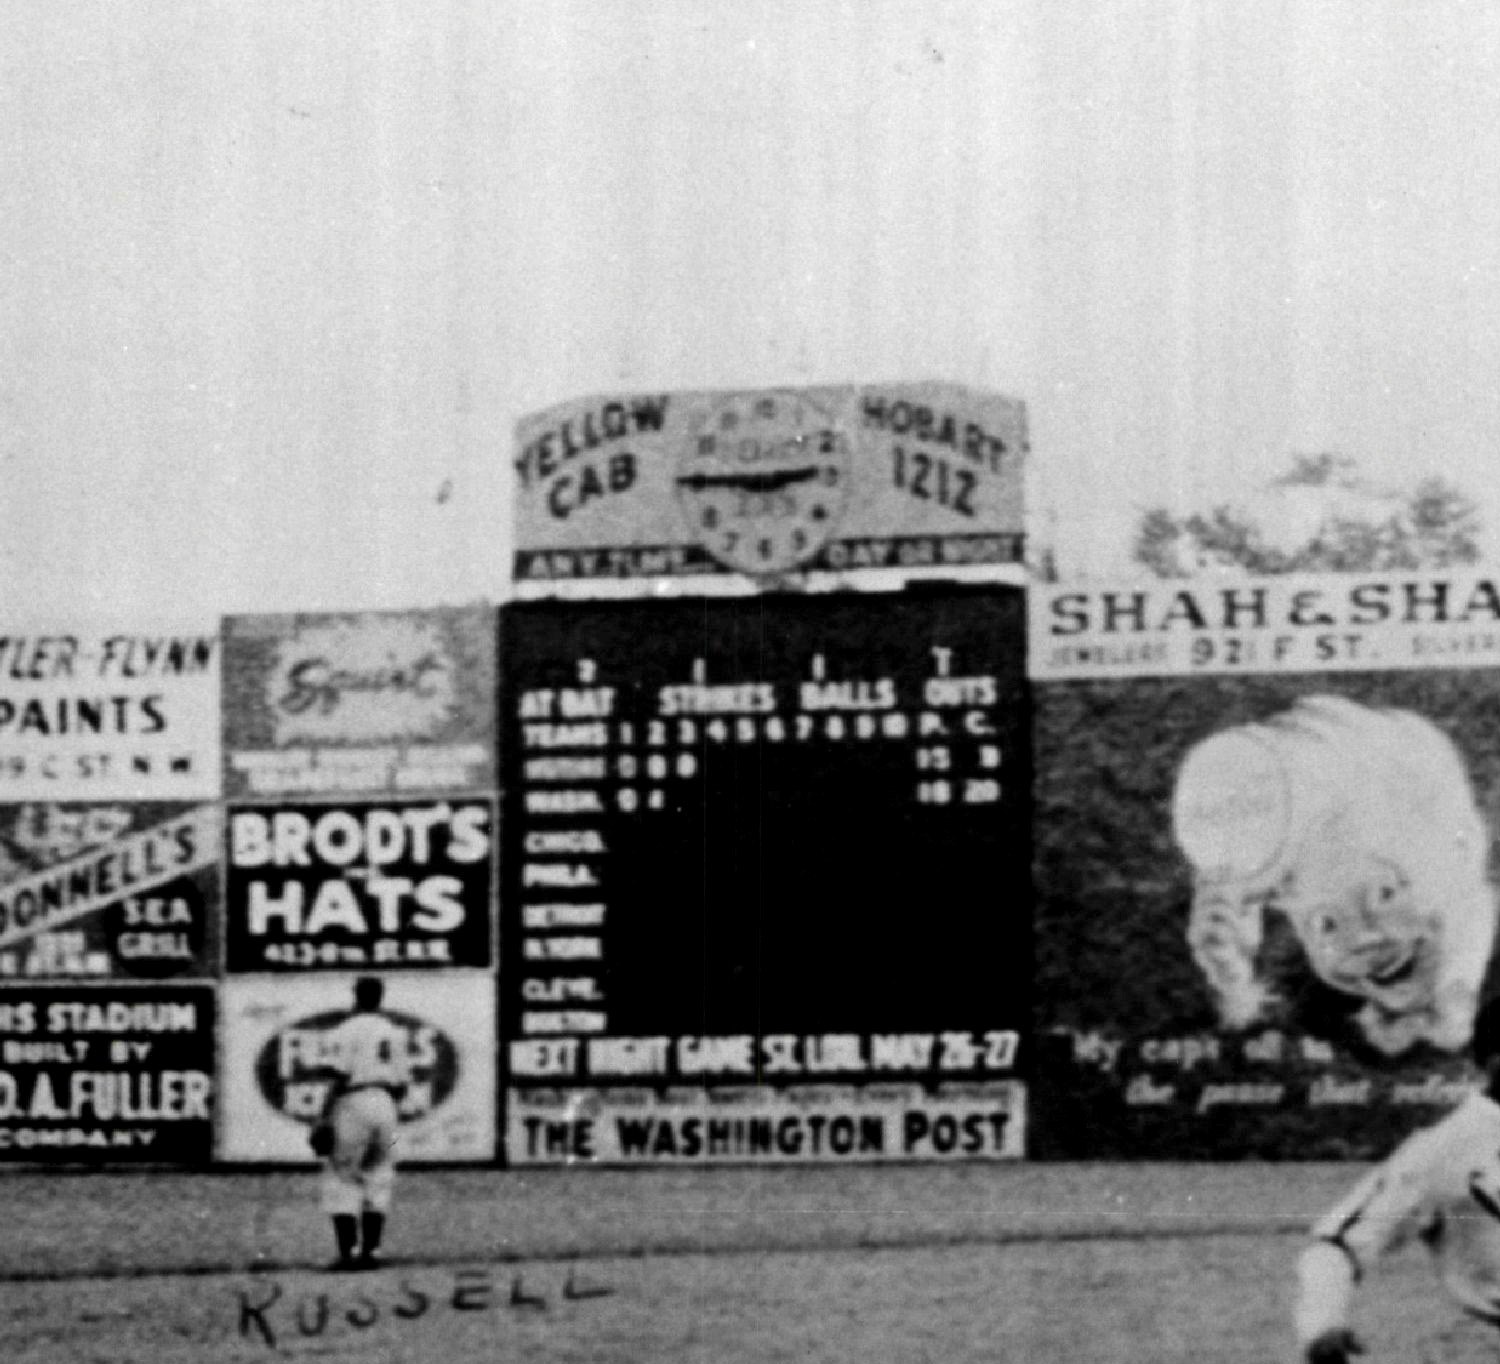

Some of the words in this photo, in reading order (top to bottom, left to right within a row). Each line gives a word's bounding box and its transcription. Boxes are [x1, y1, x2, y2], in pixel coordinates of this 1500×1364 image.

[515, 394, 670, 489] YELLOW
[862, 395, 1007, 475] HOBART
[547, 452, 637, 519] CAB
[893, 446, 978, 518] 1212
[1050, 587, 1268, 636] SHAH
[1287, 590, 1336, 627] &
[1273, 635, 1294, 662] F
[519, 687, 554, 719] AT
[559, 685, 616, 718] BAT
[657, 682, 778, 716] STRIKES
[798, 677, 898, 711] BALLS
[923, 674, 998, 706] OUTS
[231, 801, 490, 867] BRODT'S
[247, 872, 466, 936] HATS
[47, 1002, 198, 1033] STADIUM
[3, 1038, 91, 1066] BUILT
[110, 1038, 153, 1065] BY
[508, 1035, 580, 1075] NEXT
[586, 1034, 671, 1076] NIGHT
[676, 1033, 757, 1075] GAME
[870, 1031, 936, 1070] MAY
[938, 1028, 1021, 1070] 26-27
[521, 1115, 596, 1158] THE
[614, 1114, 885, 1157] WASHINGTON
[902, 1108, 1011, 1155] POST
[236, 1266, 618, 1350] RUSSELL
